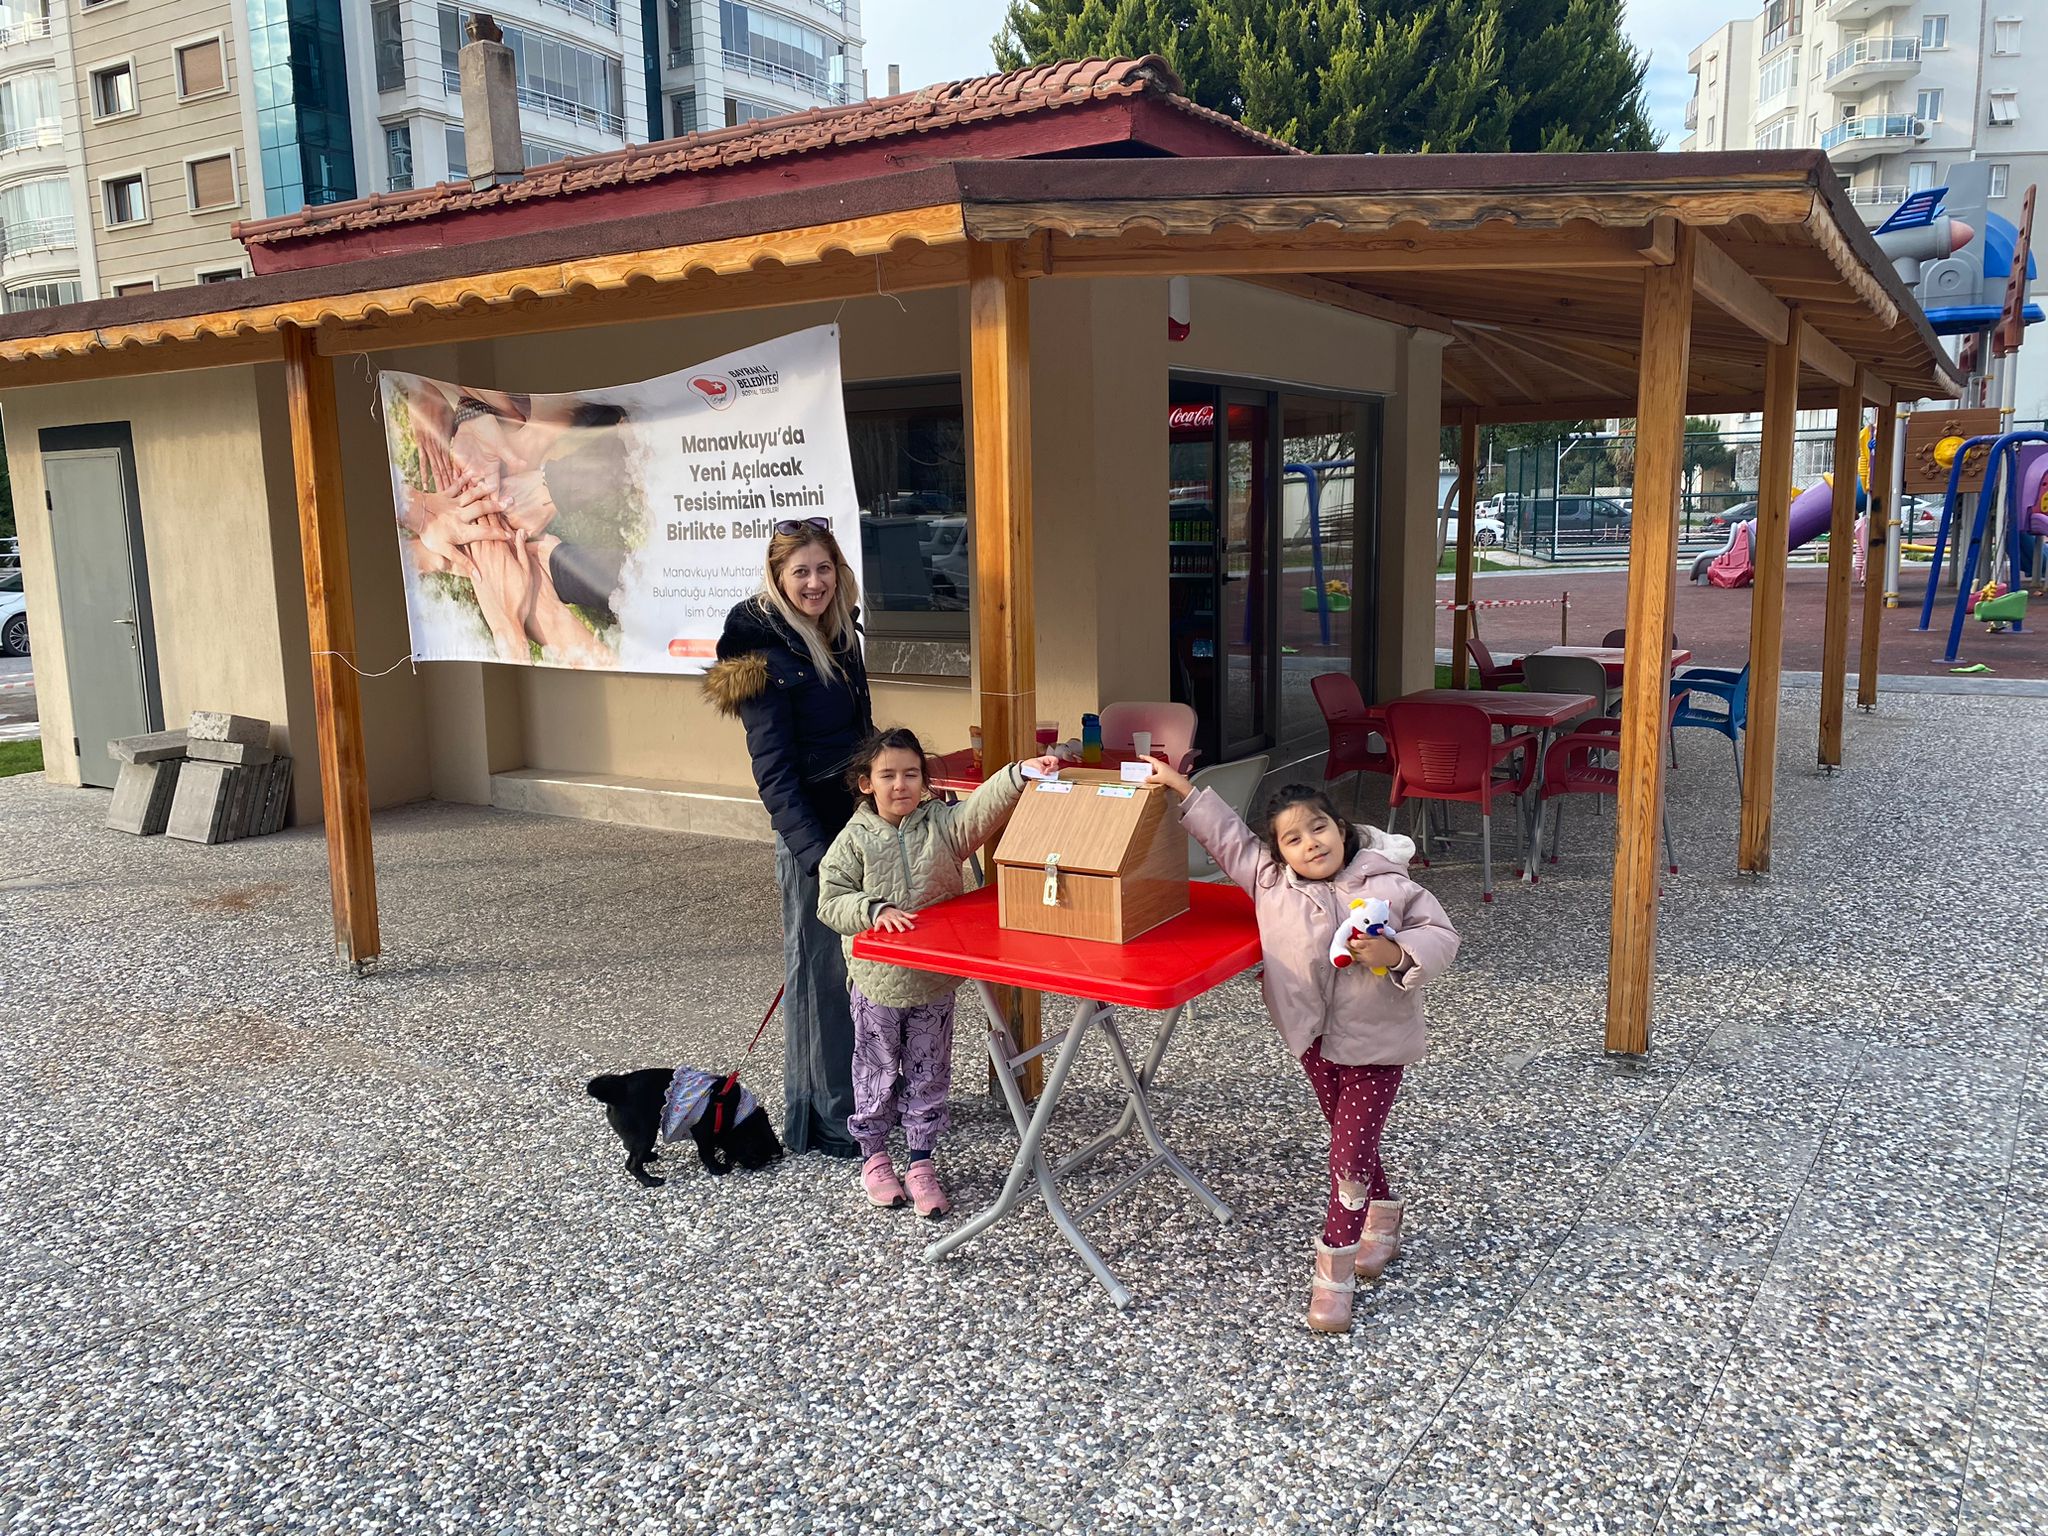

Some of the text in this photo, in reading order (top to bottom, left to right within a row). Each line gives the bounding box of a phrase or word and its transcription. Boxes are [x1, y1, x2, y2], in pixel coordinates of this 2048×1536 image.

[728, 365, 770, 378] BAYRAKLI
[736, 371, 779, 389] BELEDİYESİ
[1169, 405, 1214, 428] Coca-Col
[681, 425, 806, 455] Manavkuyu'da
[689, 457, 805, 486] Yeni Açılacak
[673, 484, 825, 512] Tesisimizin İsmini
[667, 520, 727, 541] Birlikte
[663, 567, 719, 580] Manavkuyu
[652, 587, 705, 601] Bulunduğu
[708, 586, 743, 598] Alanda
[684, 605, 704, 618] İsim
